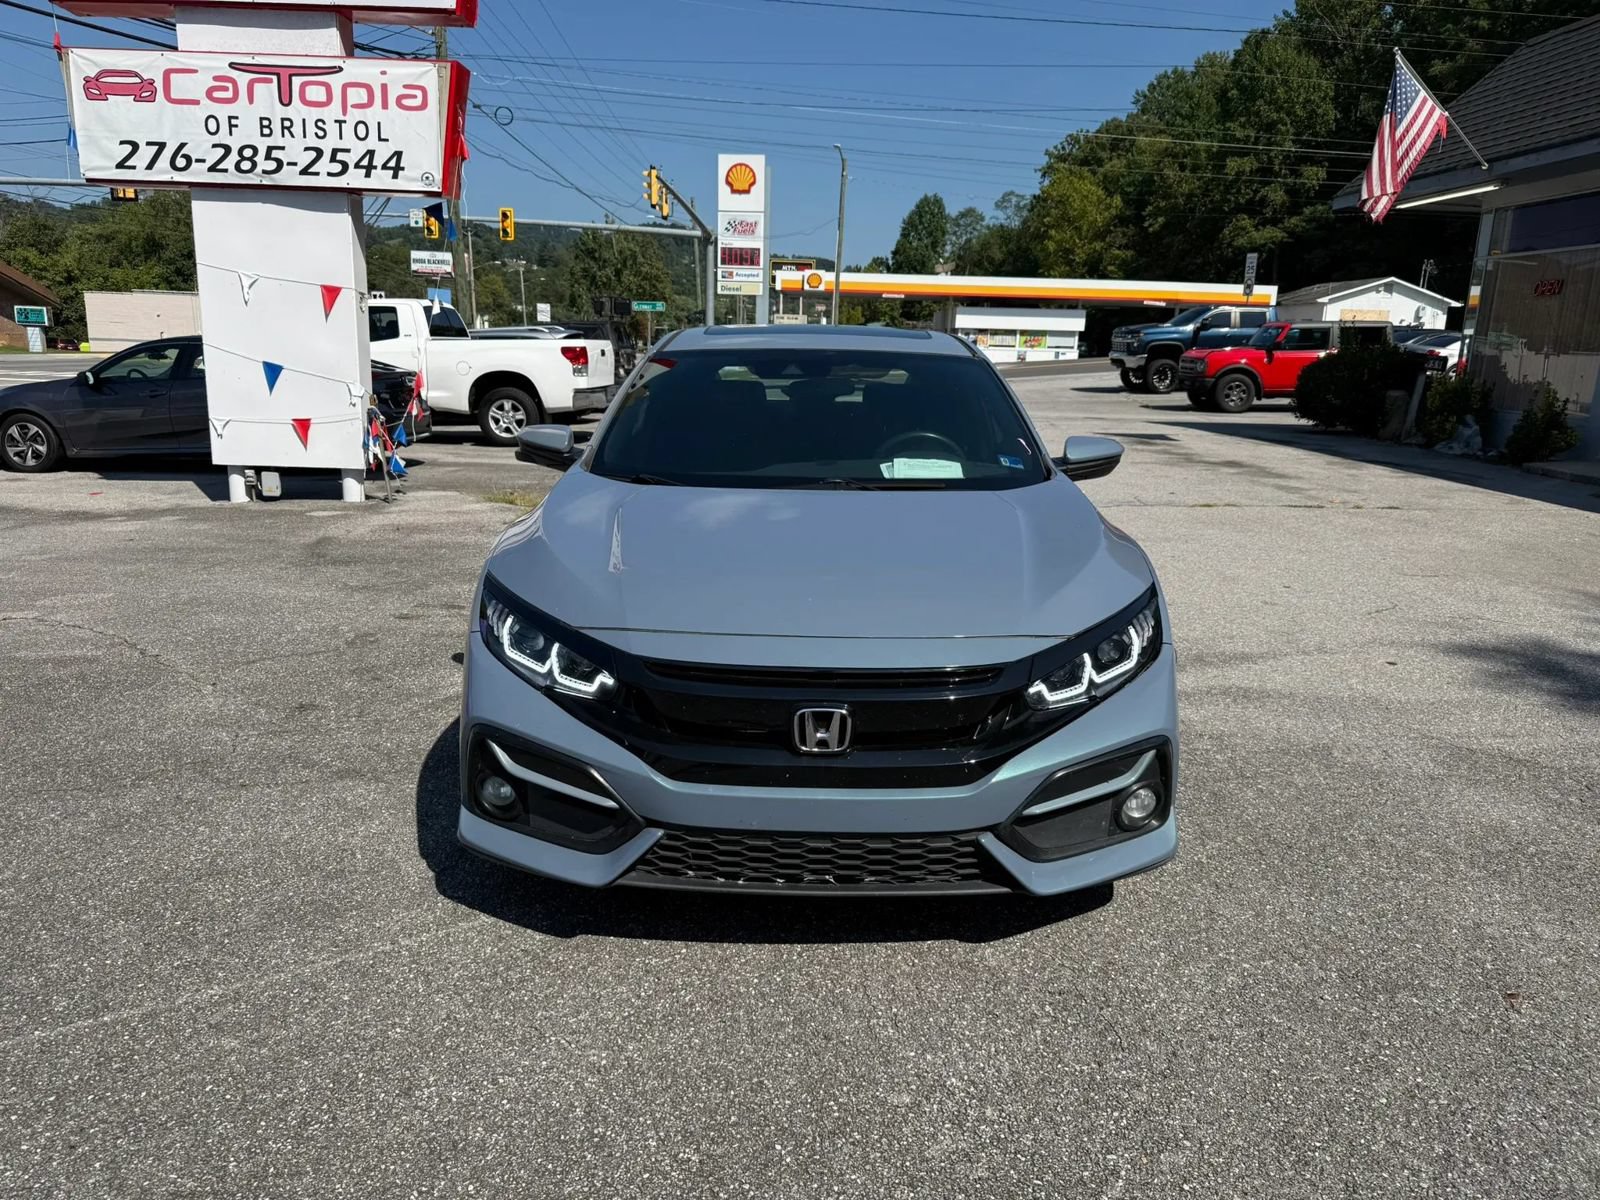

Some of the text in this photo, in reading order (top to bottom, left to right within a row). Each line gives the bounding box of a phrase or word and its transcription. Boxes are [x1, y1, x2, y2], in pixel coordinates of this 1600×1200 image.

[162, 62, 429, 117] CarTopia
[204, 114, 390, 142] OF BRISTOL
[115, 139, 406, 180] 276-285-2544
[720, 284, 742, 292] Diesel
[1534, 279, 1561, 296] OPEN
